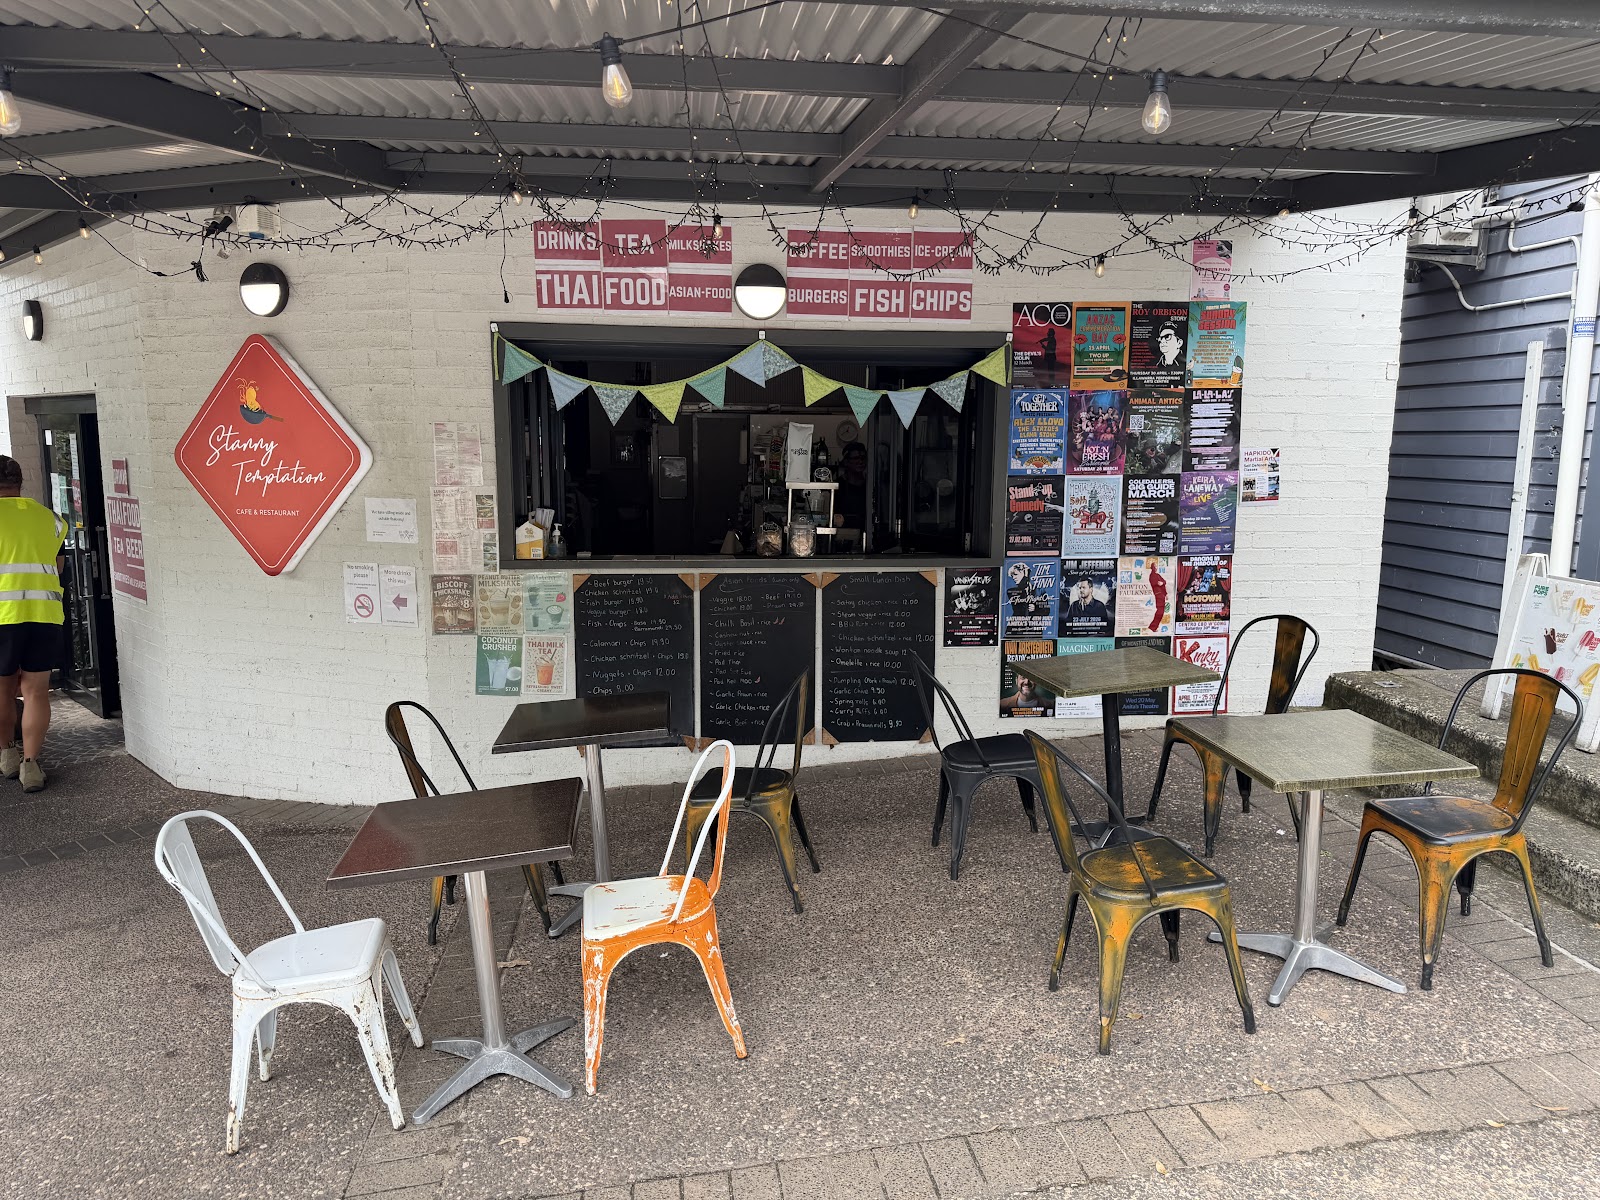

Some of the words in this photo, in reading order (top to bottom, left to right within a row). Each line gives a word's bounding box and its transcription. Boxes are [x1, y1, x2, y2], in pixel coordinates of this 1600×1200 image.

[537, 231, 596, 250] DRINKS
[615, 234, 654, 255] TEA
[852, 246, 910, 257] SMOOTHIES
[915, 246, 971, 257] ICE-CREAM
[537, 274, 598, 304] THAI
[605, 278, 665, 305] FOOD
[669, 287, 731, 299] ASIAN-FOOD
[789, 289, 847, 304] BURGERS
[855, 289, 904, 312] FISH
[913, 290, 971, 311] CHIPS
[1015, 304, 1071, 326] ACO
[1086, 314, 1115, 325] ANZAC
[1201, 309, 1236, 319] SUNDAY
[1198, 319, 1236, 330] SESSION
[1092, 332, 1108, 343] DAY
[1032, 394, 1046, 402] GET
[1021, 401, 1058, 411] TOGETHER
[1014, 418, 1035, 426] ALEX
[206, 425, 278, 467] Stanny
[232, 460, 326, 497] Temptation
[1193, 476, 1215, 484] KEIRA
[1184, 484, 1223, 492] LANEWAY
[1128, 490, 1174, 498] MARCH
[1194, 494, 1211, 502] LIVE
[1010, 500, 1044, 513] Comedy
[108, 500, 123, 524] THAI
[122, 502, 140, 527] FOOD
[114, 537, 124, 554] TEA
[126, 538, 143, 559] BEER
[1033, 562, 1054, 576] TIM
[1064, 561, 1077, 569] JIM
[1079, 561, 1114, 569] JEFFERIES
[437, 581, 468, 589] BISCOFF
[1031, 575, 1055, 590] FINN
[434, 588, 470, 597] THICKSHAKE
[1005, 641, 1017, 654] IVAN
[1060, 645, 1094, 653] IMAGINE
